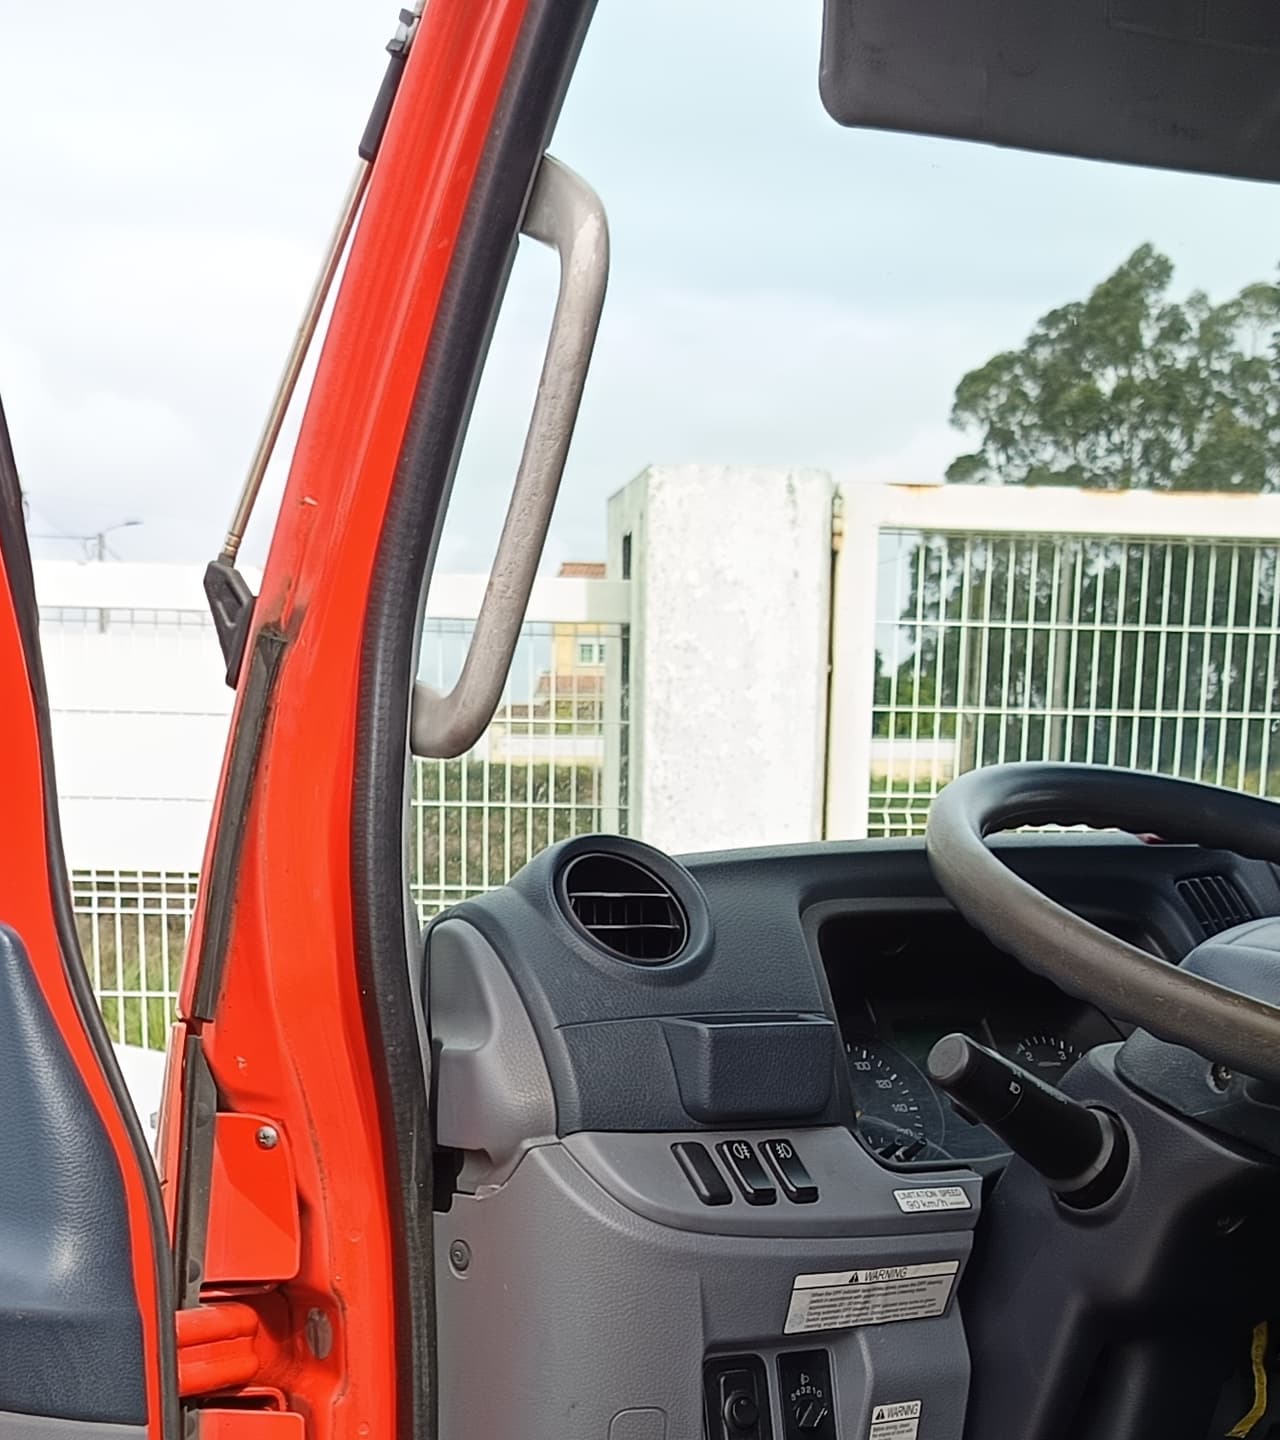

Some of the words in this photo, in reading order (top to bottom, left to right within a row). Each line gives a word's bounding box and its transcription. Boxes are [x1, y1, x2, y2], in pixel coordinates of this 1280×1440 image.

[1057, 1051, 1067, 1060] 3
[854, 1061, 871, 1071] 100
[875, 1079, 893, 1089] 120
[906, 1199, 920, 1209] 90
[920, 1198, 949, 1208] km/h
[864, 1266, 908, 1281] WARNING
[887, 1402, 919, 1418] WARNING
